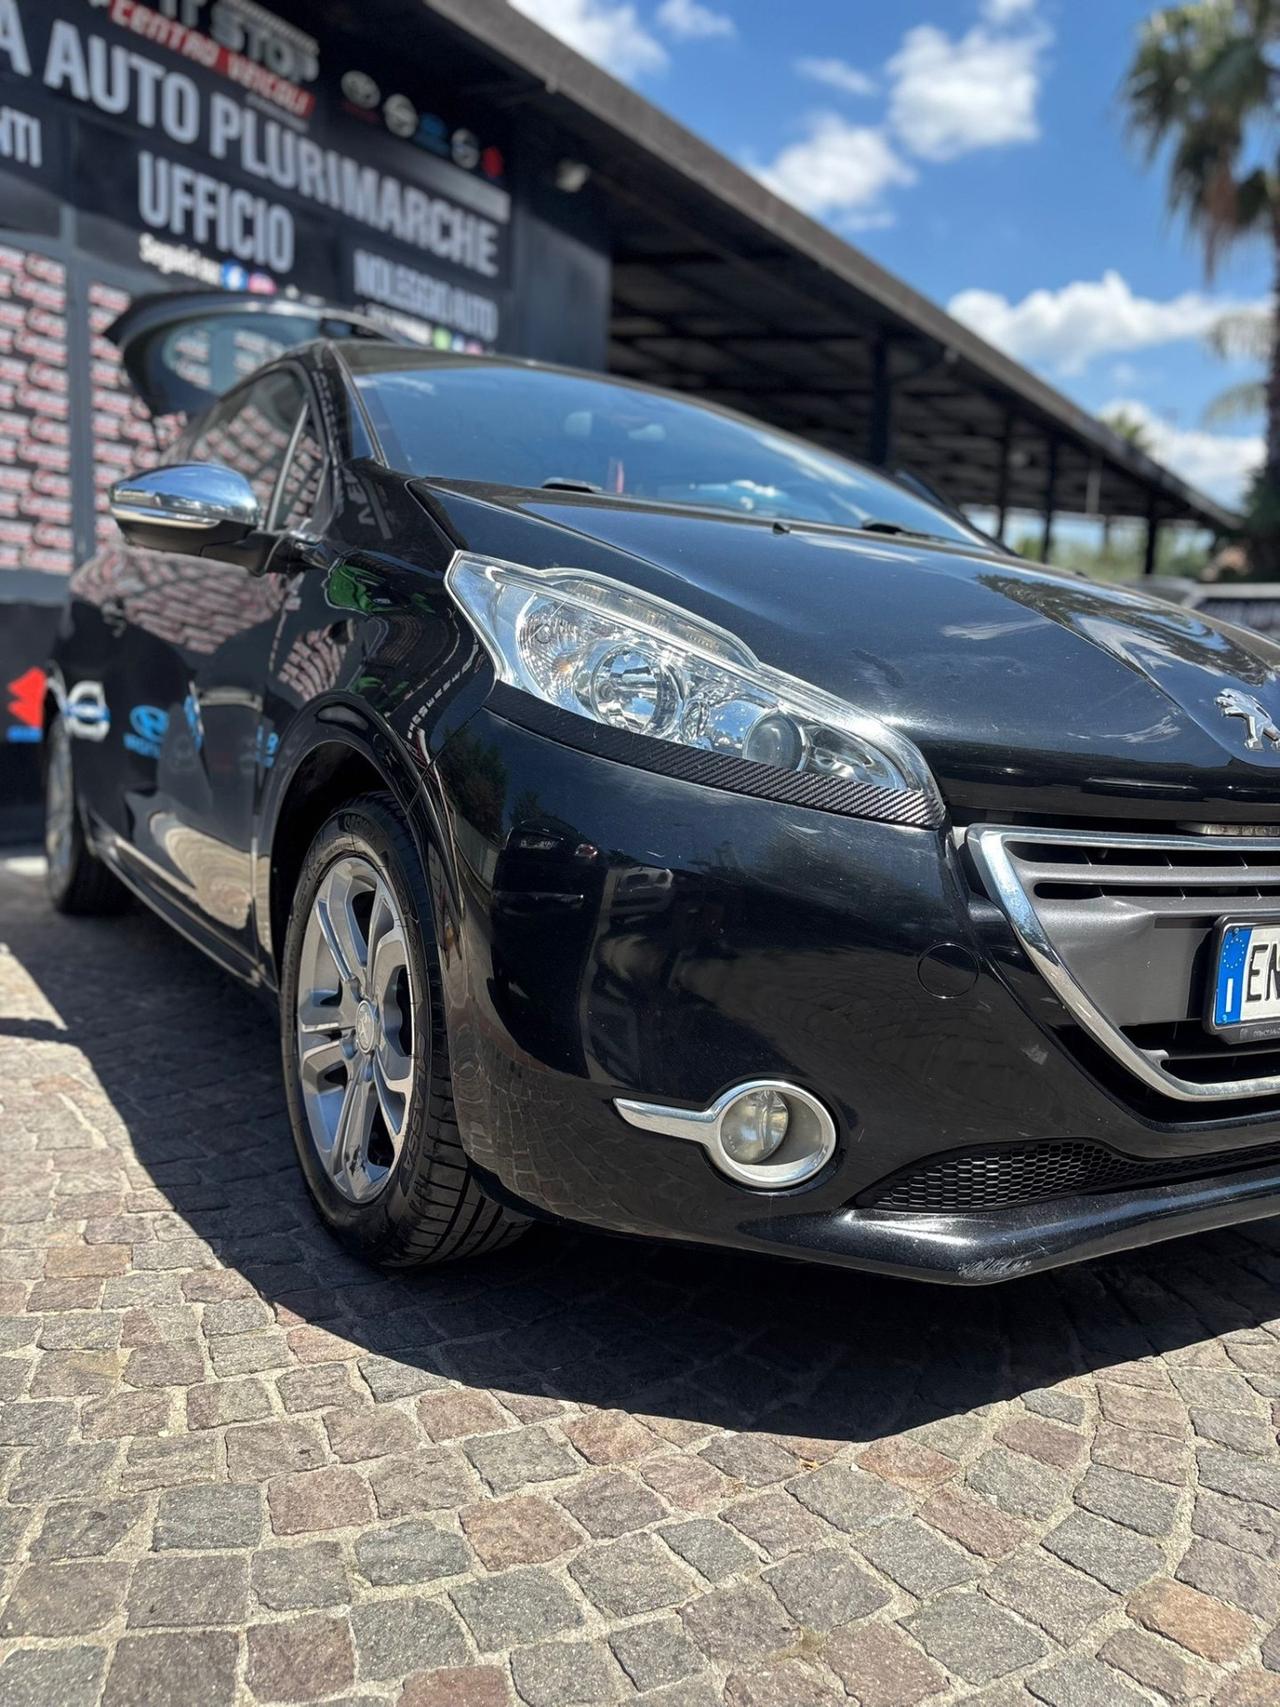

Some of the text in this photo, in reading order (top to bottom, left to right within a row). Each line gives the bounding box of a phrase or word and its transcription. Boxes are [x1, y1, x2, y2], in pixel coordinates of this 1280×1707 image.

[43, 18, 200, 144] AUTO
[209, 91, 499, 278] PLURIMARCHE
[138, 150, 294, 274] UFFICIO
